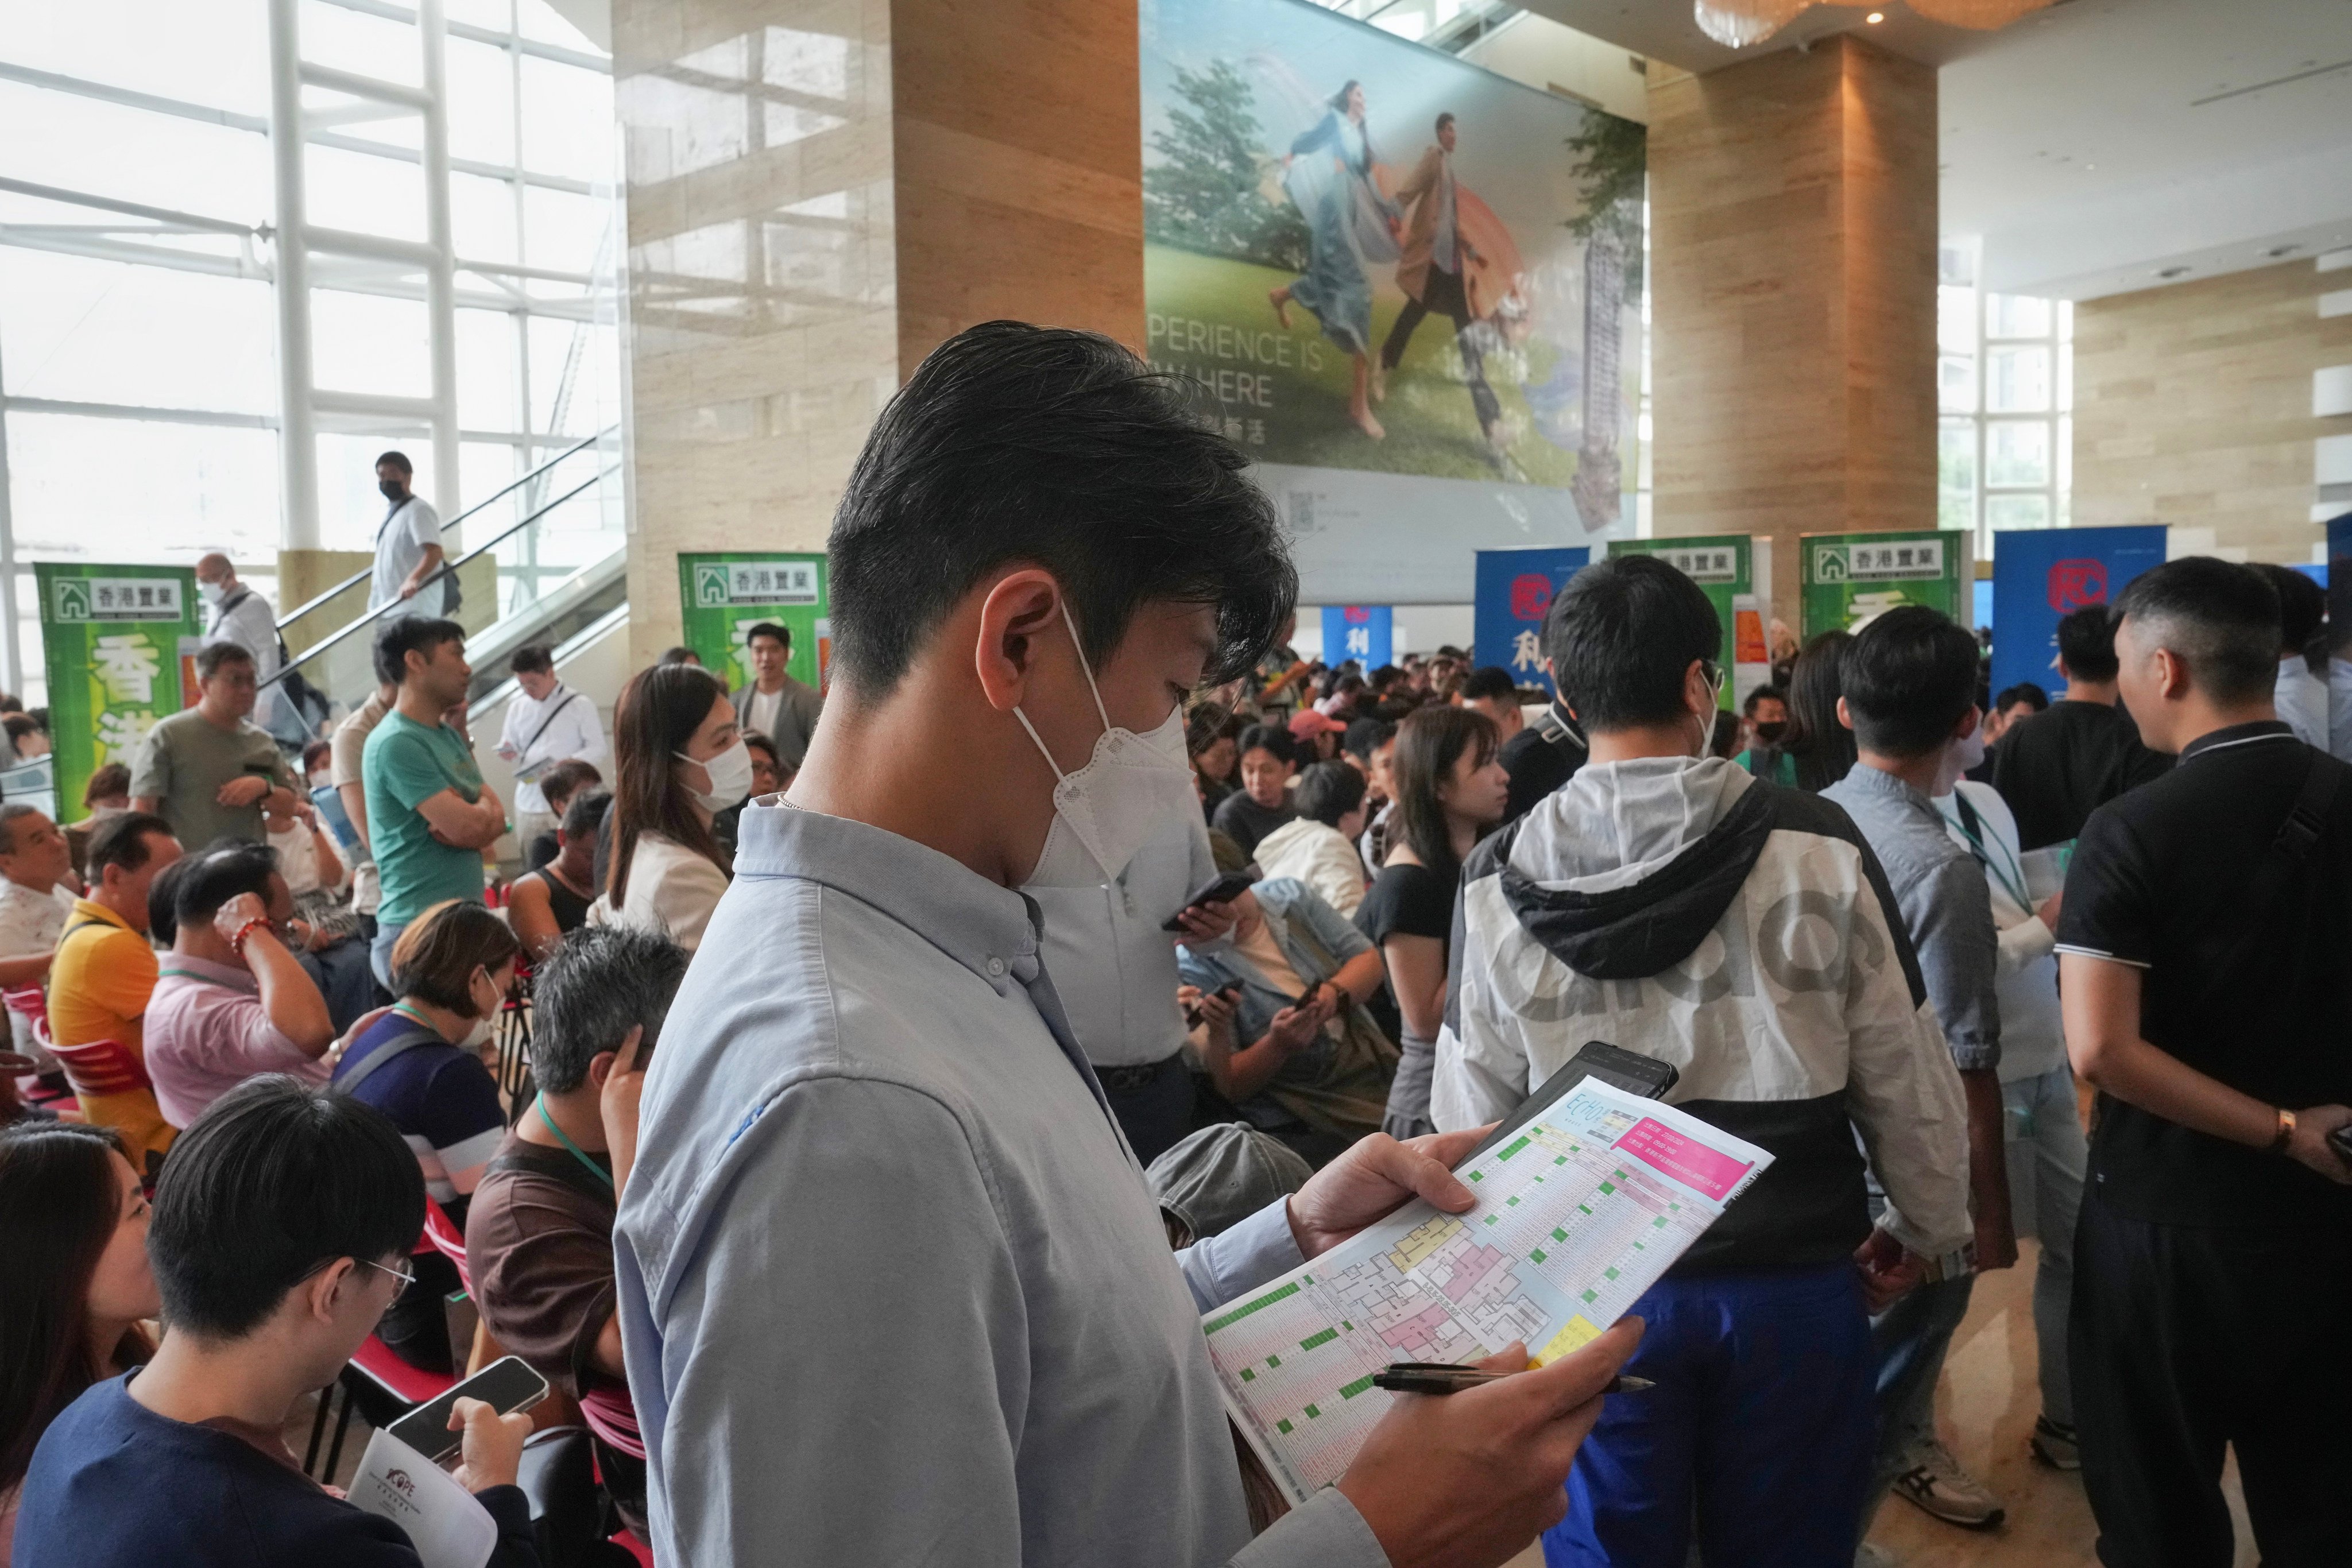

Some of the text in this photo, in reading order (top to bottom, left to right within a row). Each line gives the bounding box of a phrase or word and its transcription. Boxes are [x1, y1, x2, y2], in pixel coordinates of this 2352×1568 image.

[1301, 340, 1322, 372] IS
[1196, 366, 1273, 408] HERE
[736, 570, 808, 592] 香港置業
[98, 584, 172, 608] 香港置業
